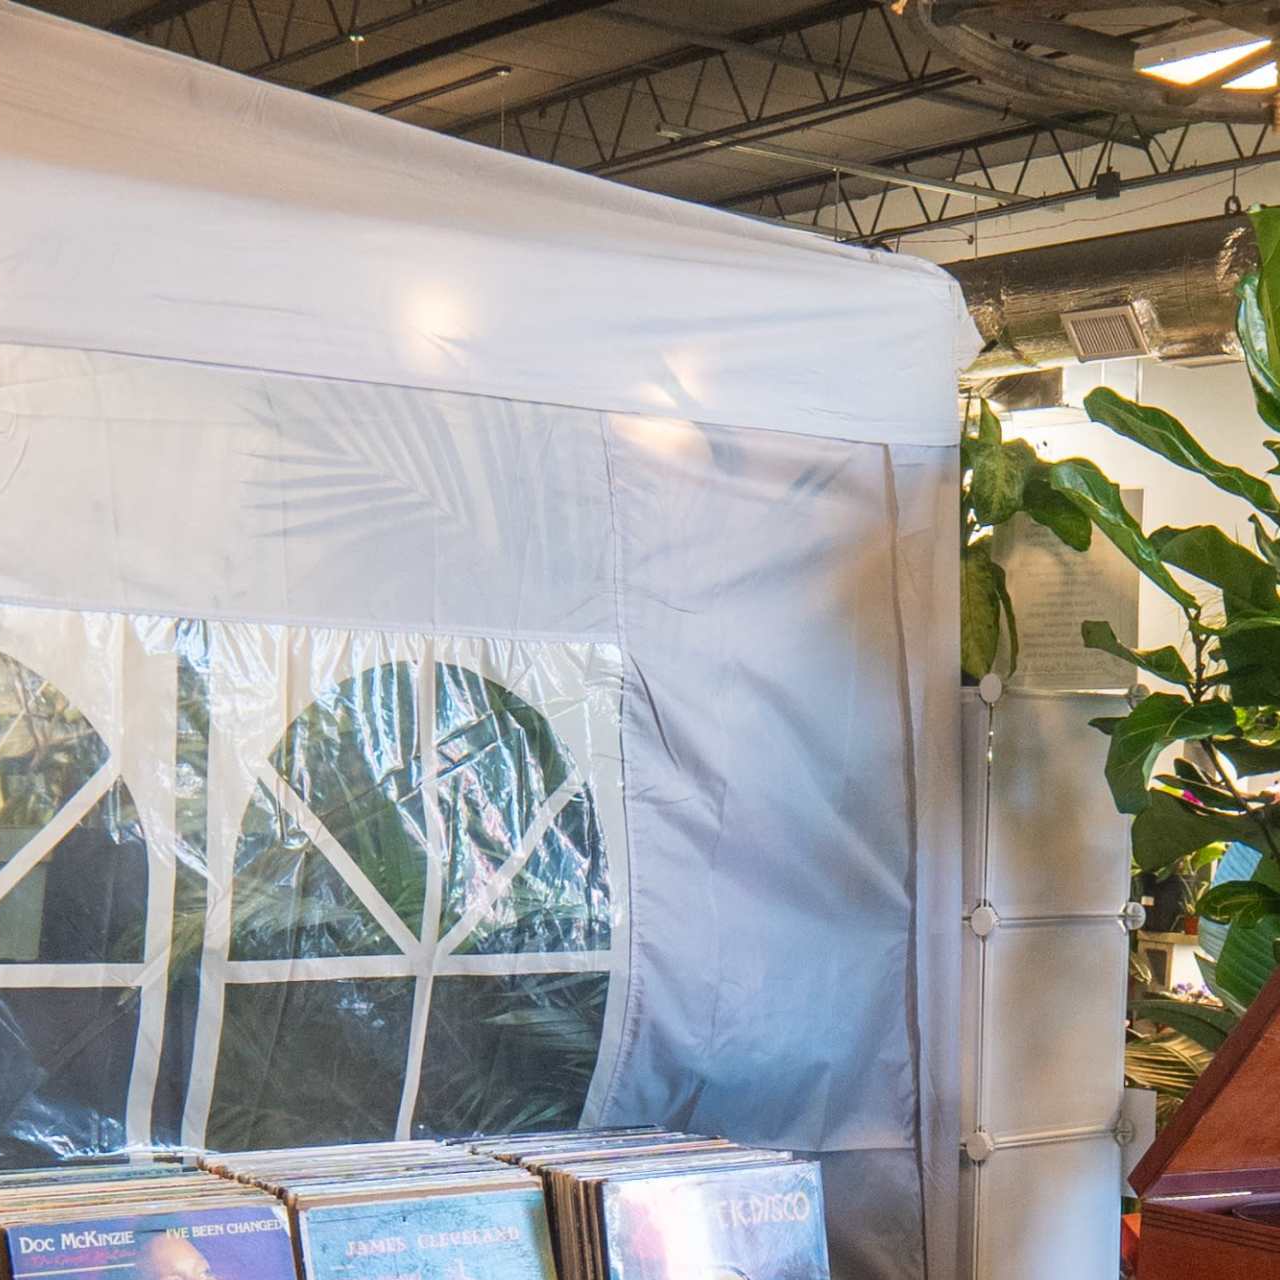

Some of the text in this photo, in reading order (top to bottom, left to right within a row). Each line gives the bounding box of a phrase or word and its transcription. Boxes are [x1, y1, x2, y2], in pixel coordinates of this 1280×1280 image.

[166, 1217, 282, 1239] I'VE BEEN CHANGED
[19, 1235, 56, 1255] DOC
